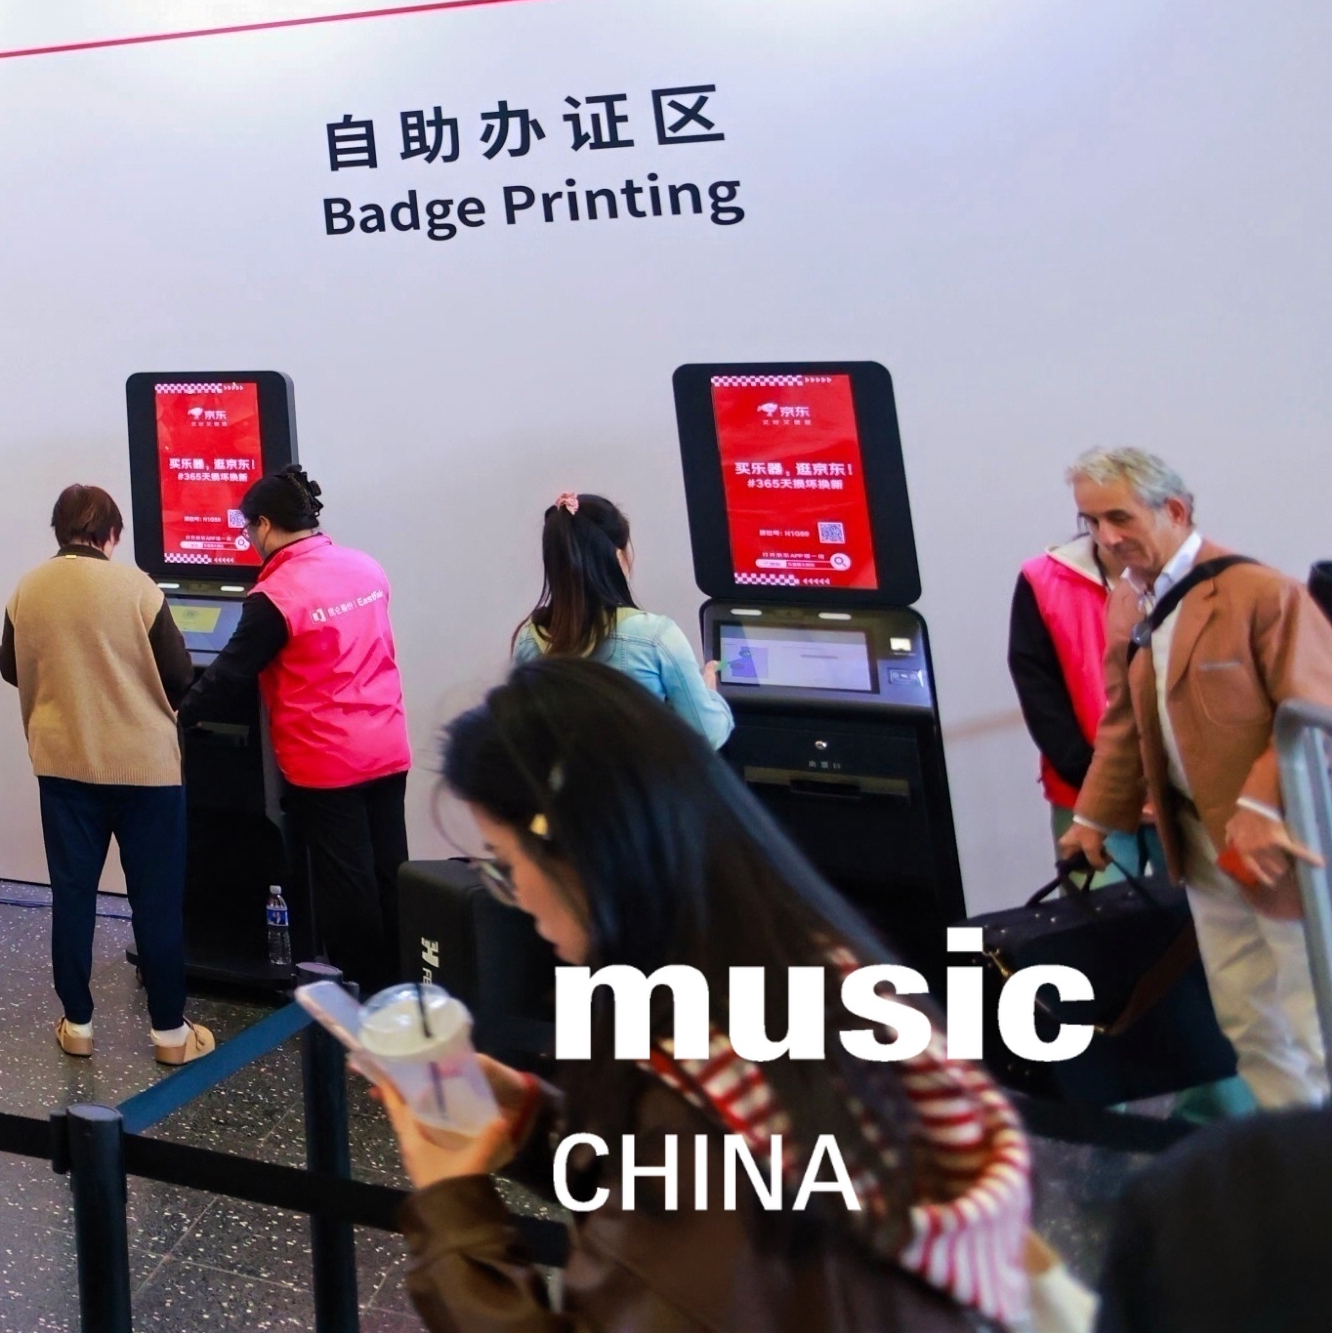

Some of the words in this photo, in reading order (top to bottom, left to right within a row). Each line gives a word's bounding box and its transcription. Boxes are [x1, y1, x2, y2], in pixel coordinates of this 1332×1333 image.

[325, 83, 725, 172] 自助办证区
[322, 188, 487, 241] Badge
[502, 172, 746, 226] Printing
[779, 406, 810, 418] 京东
